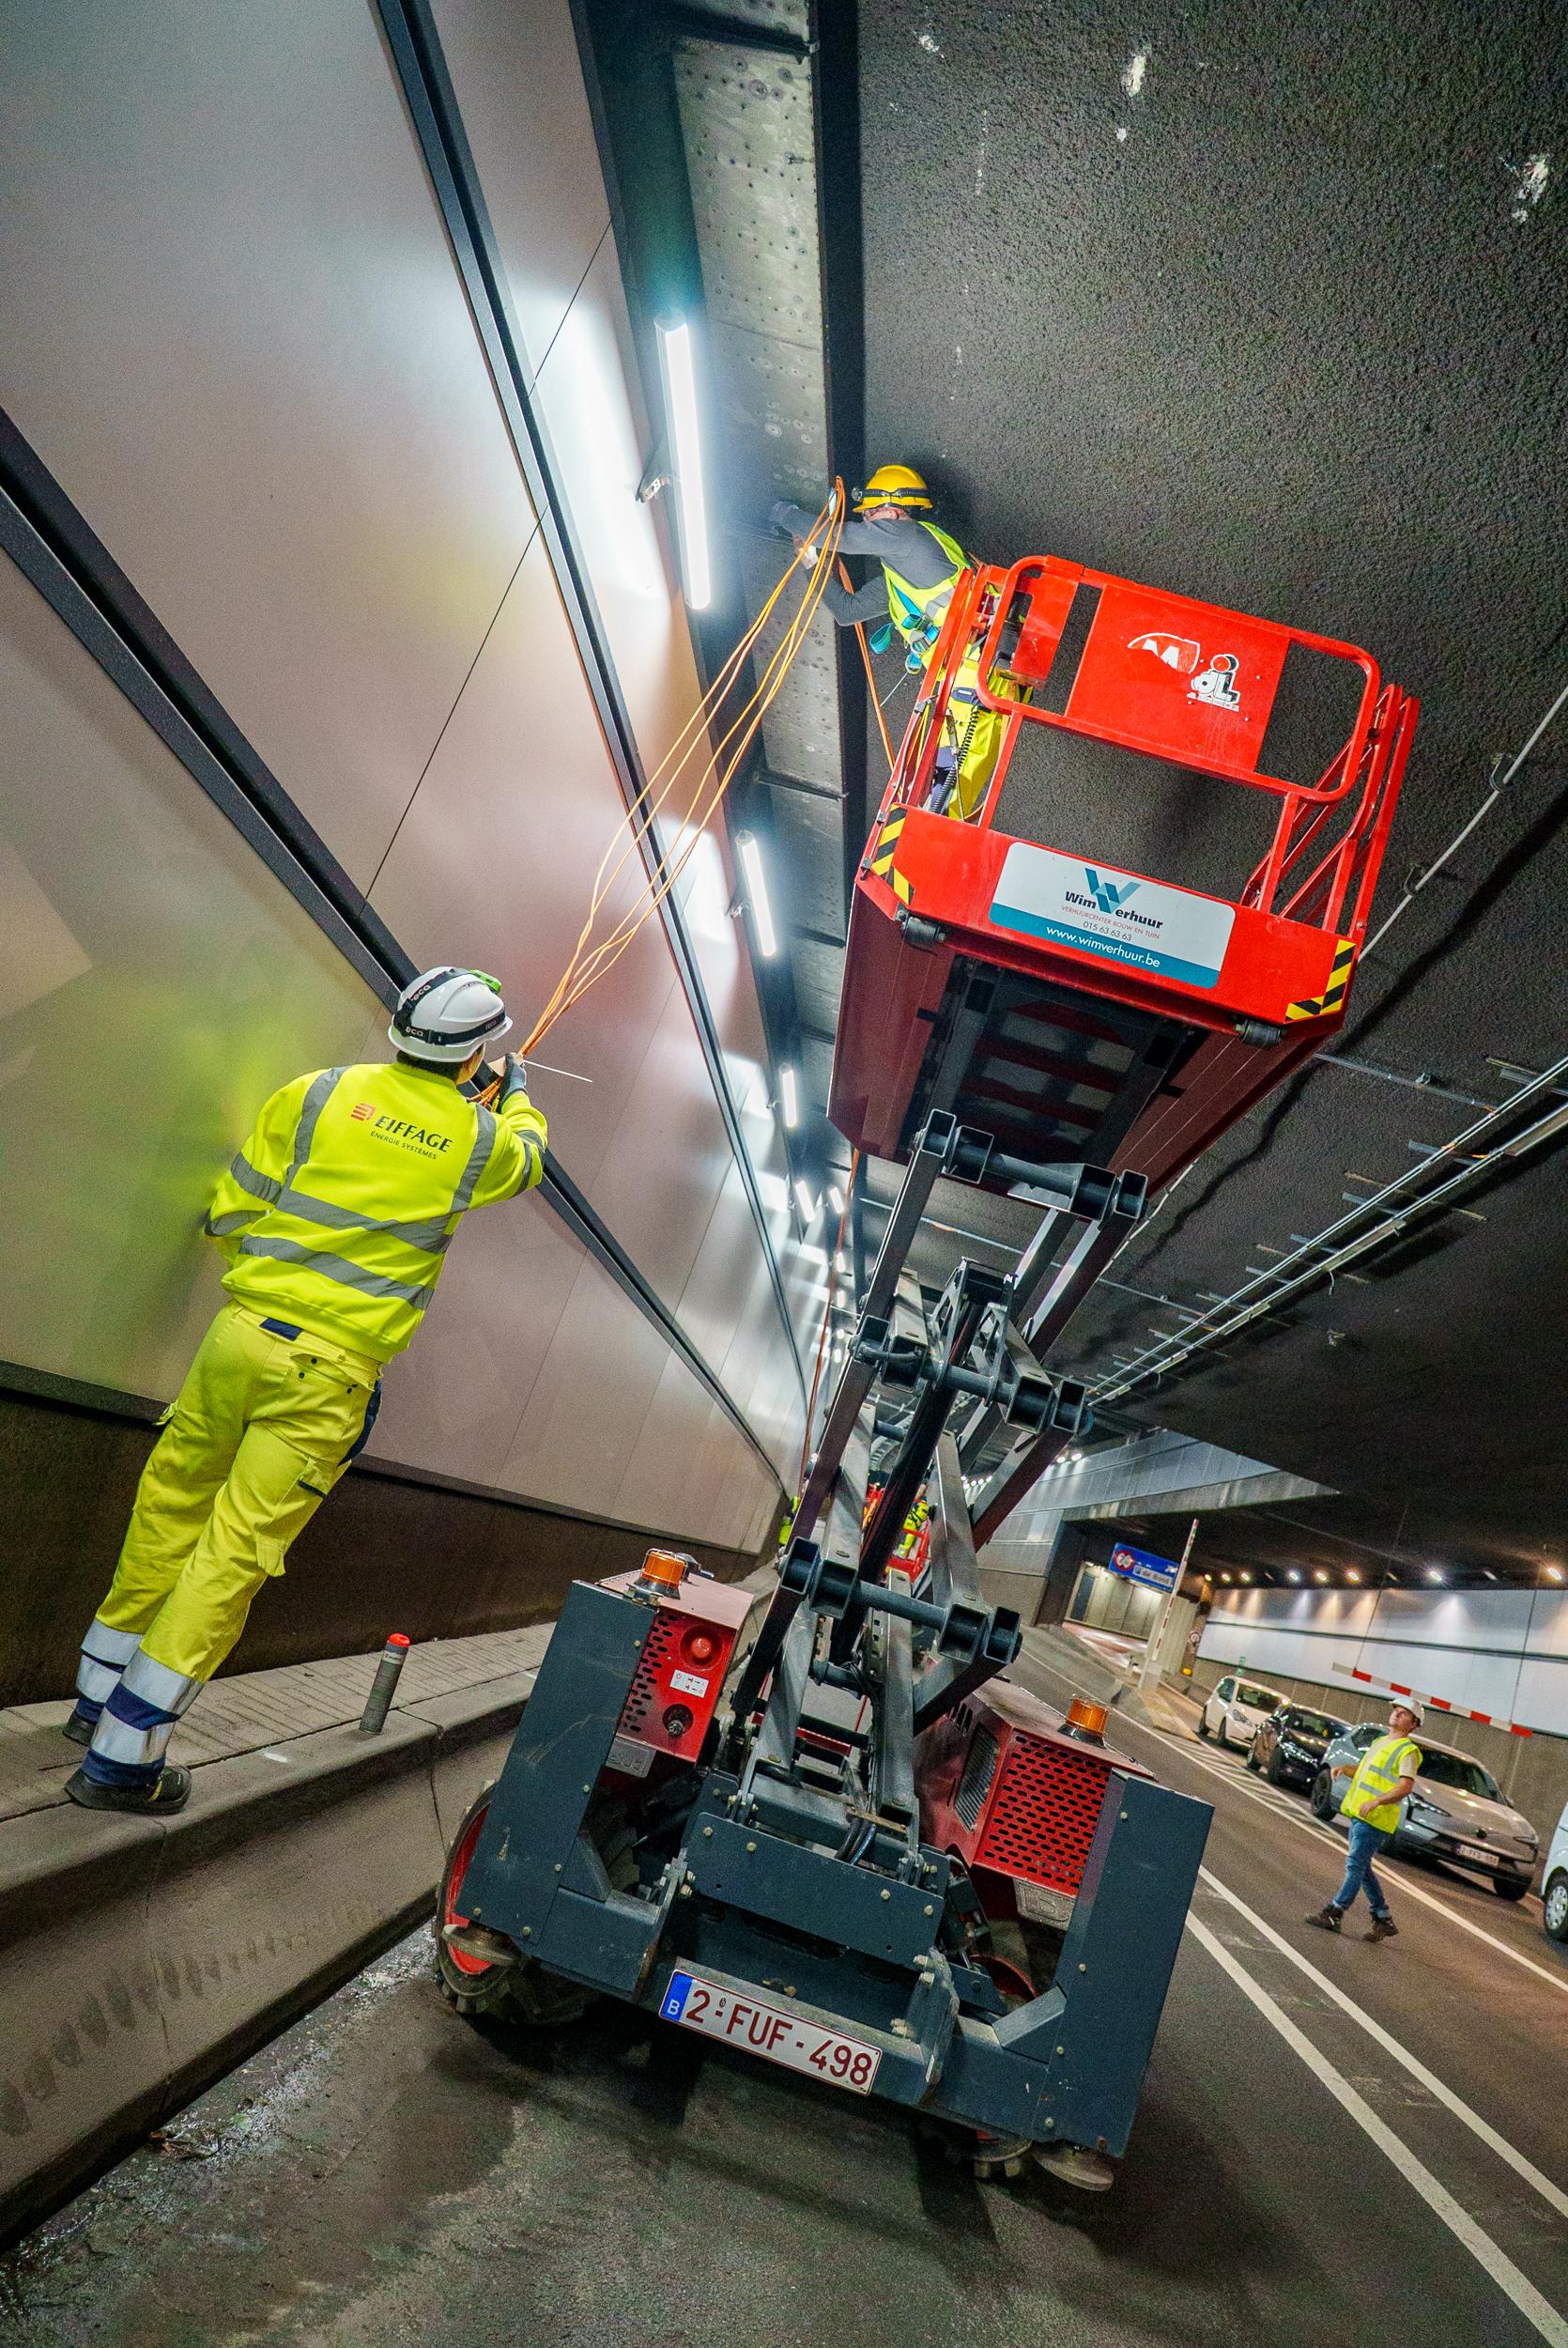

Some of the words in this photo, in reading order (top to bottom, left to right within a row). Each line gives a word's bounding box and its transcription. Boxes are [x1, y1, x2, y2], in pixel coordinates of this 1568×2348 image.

[1065, 890, 1098, 910] Wim
[1061, 904, 1112, 925] VERHUURCENTER
[1113, 919, 1134, 932] BOUW
[1134, 926, 1144, 935] EN
[1145, 930, 1161, 940] TUIN
[1083, 920, 1099, 932] 015
[1099, 924, 1110, 935] 63
[1111, 928, 1121, 939] 63
[1122, 932, 1132, 943] 63
[1046, 926, 1161, 968] www.wimverhuur.be
[375, 1115, 453, 1153] EIFFAGE
[666, 1999, 681, 2016] B
[685, 1989, 873, 2086] 2-FUF-498
